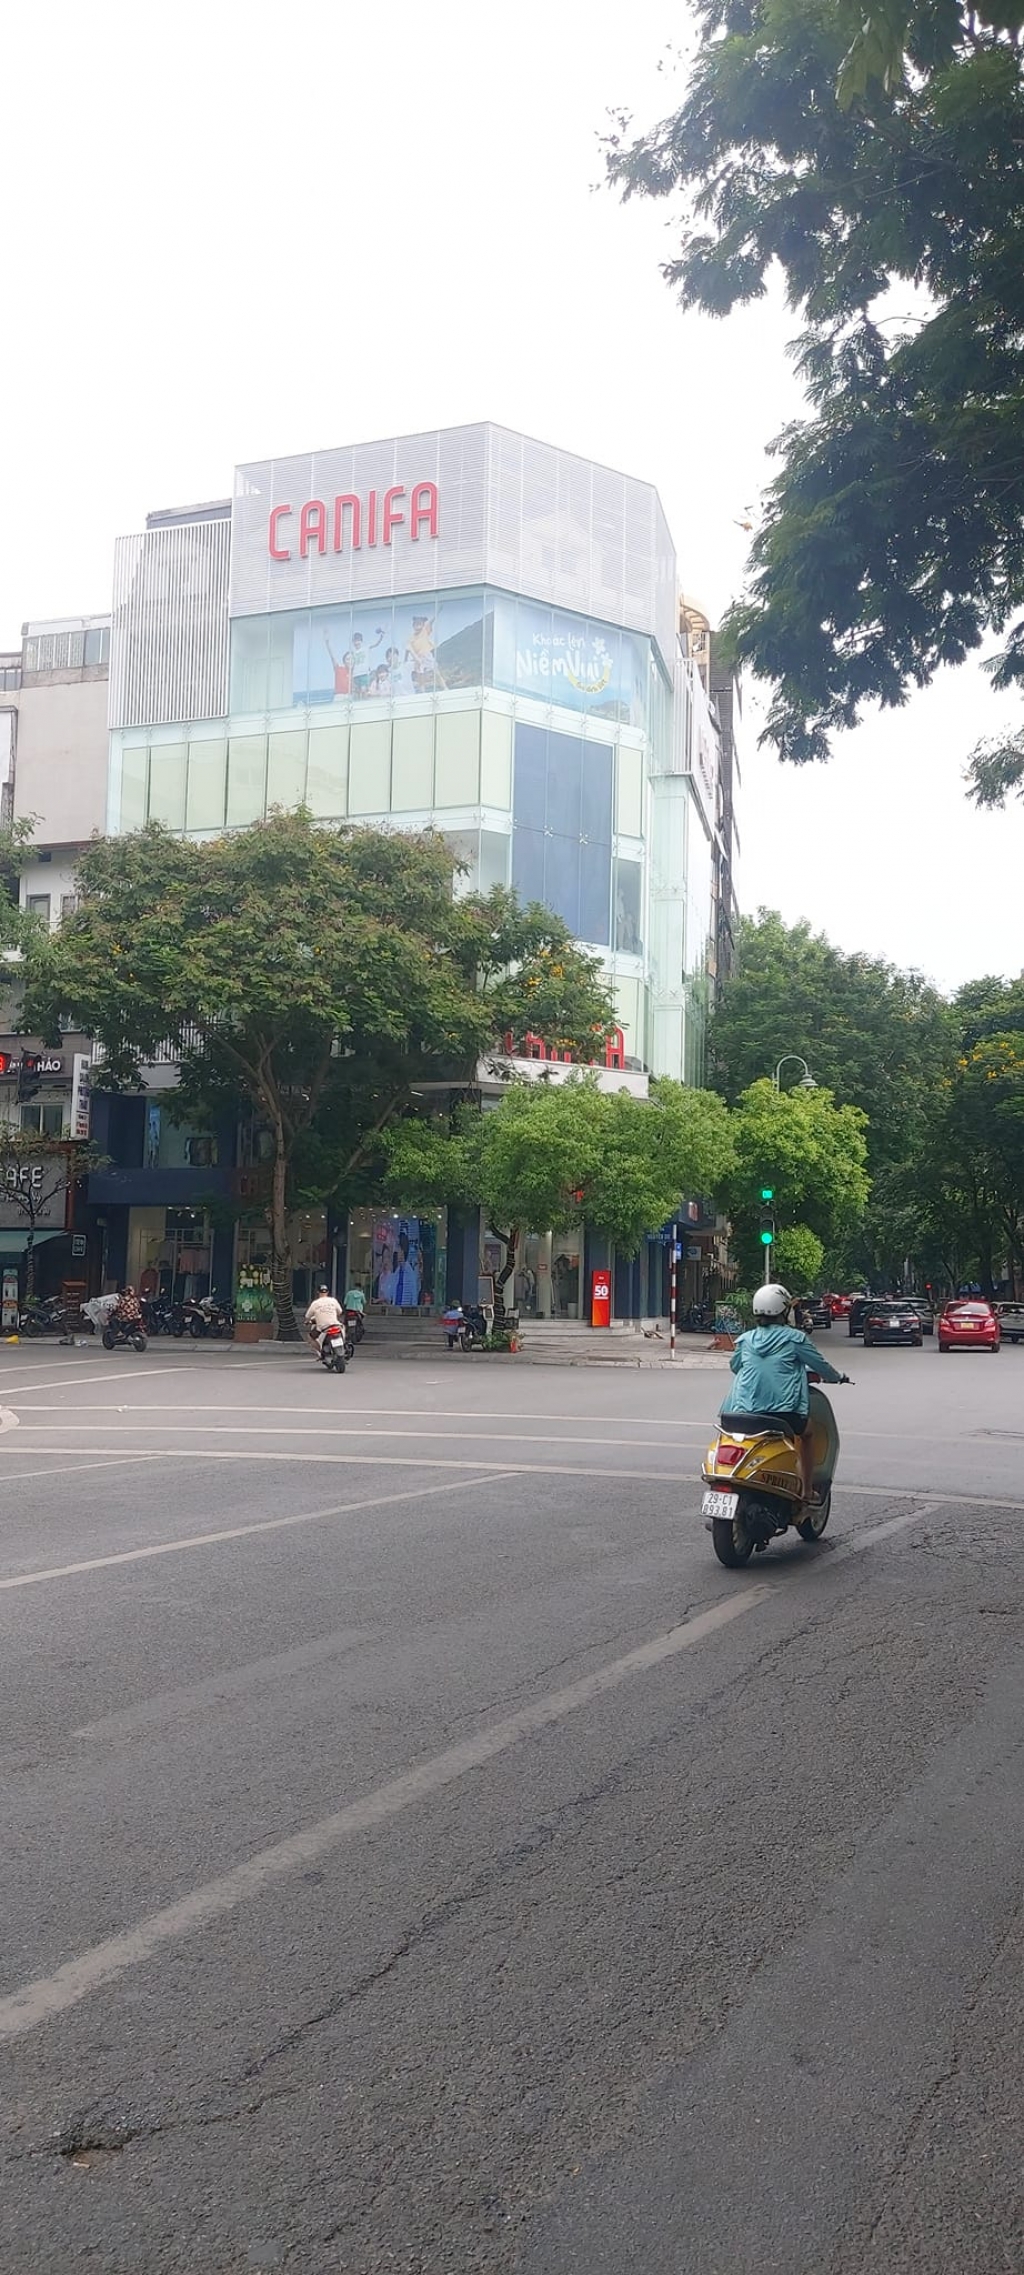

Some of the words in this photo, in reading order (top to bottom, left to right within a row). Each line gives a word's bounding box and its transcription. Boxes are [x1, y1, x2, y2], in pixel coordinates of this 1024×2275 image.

[269, 481, 438, 560] CANIFA
[0, 1166, 42, 1188] AFE
[595, 1285, 609, 1296] 50
[708, 1493, 733, 1506] 29-C1
